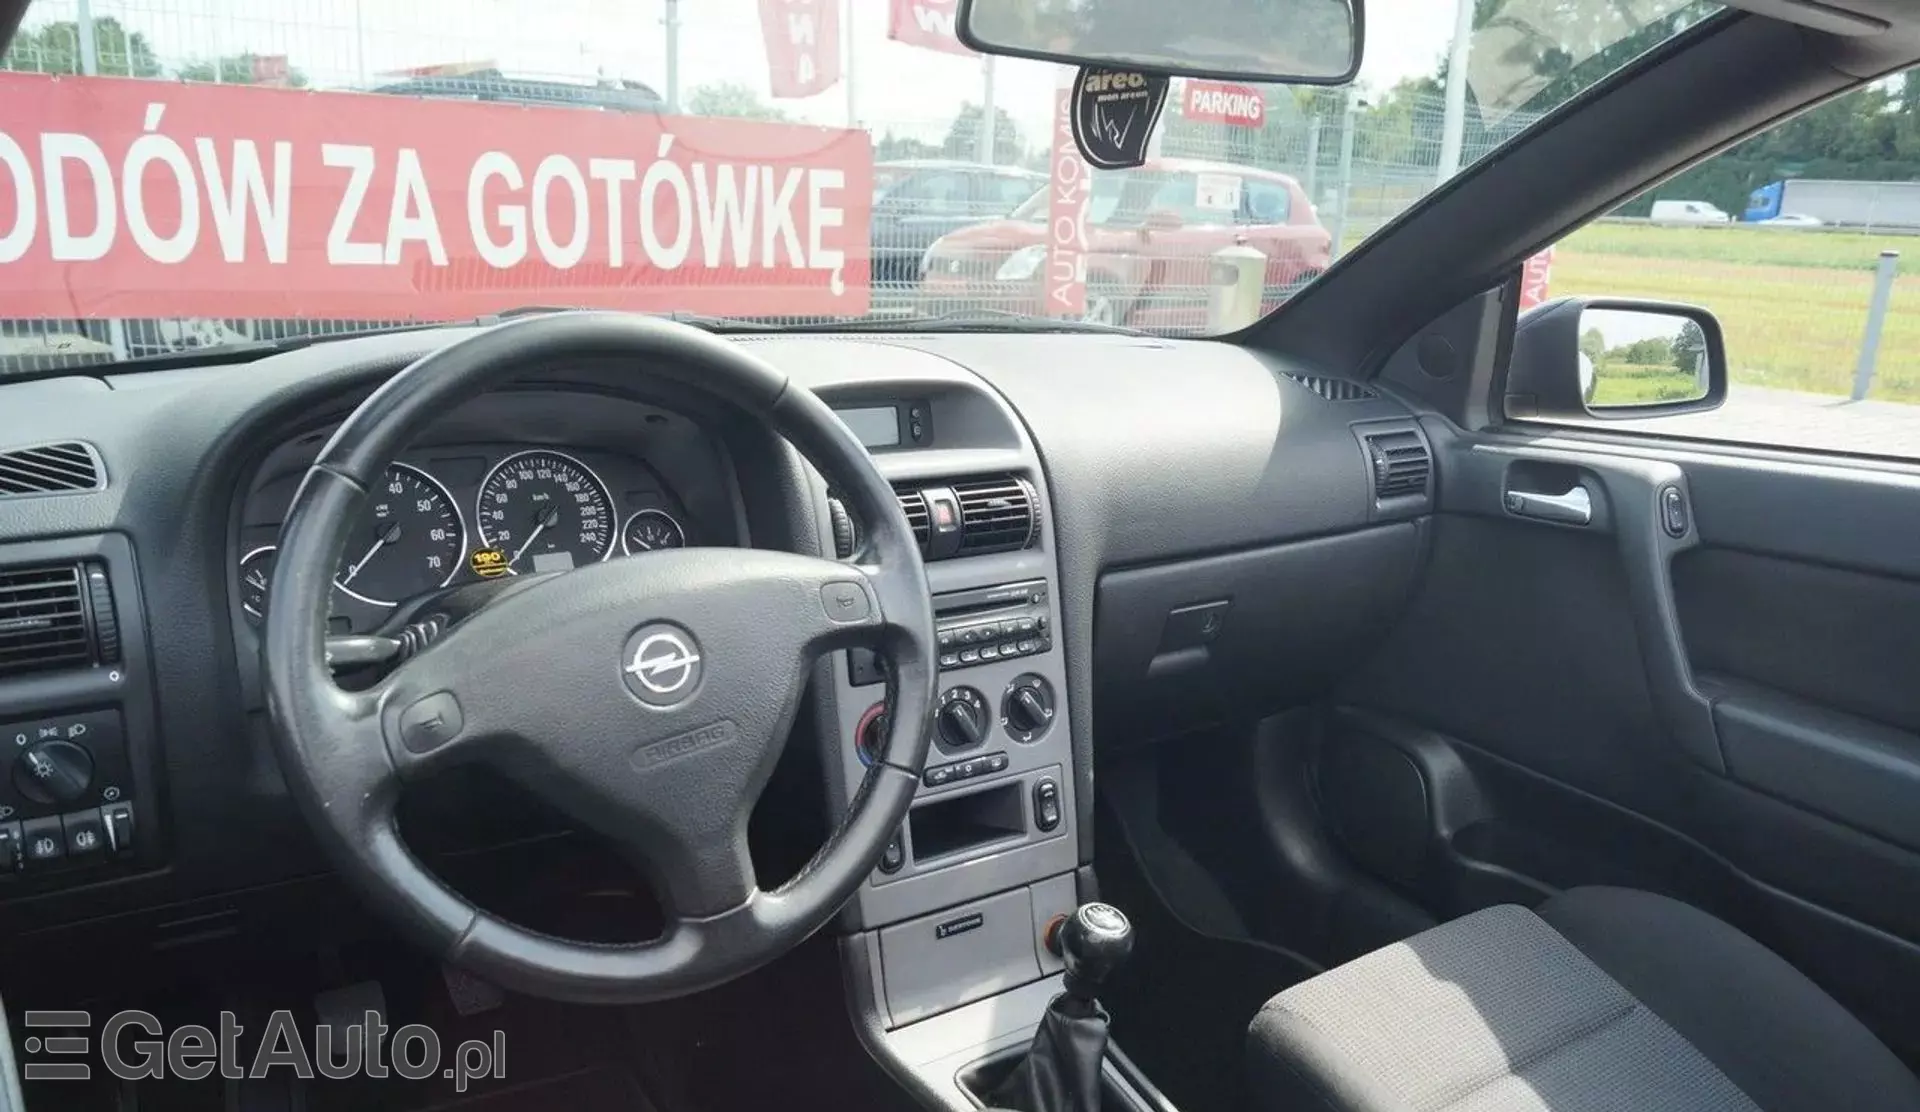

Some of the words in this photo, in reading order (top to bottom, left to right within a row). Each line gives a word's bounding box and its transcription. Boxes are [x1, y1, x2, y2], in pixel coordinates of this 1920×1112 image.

[1086, 72, 1147, 92] areo
[1190, 89, 1261, 120] PARKING
[322, 144, 448, 267] ZA
[468, 134, 845, 295] GOTÓWKĘ
[1052, 216, 1076, 306] AUTO
[1525, 256, 1548, 302] AUT
[536, 469, 552, 479] 120
[388, 482, 403, 494] 40
[417, 500, 431, 512] 50
[430, 529, 445, 541] 60
[498, 530, 510, 541] 20
[427, 556, 441, 569] 70
[951, 689, 958, 698] 2
[964, 691, 970, 700] 3
[973, 699, 980, 708] 4
